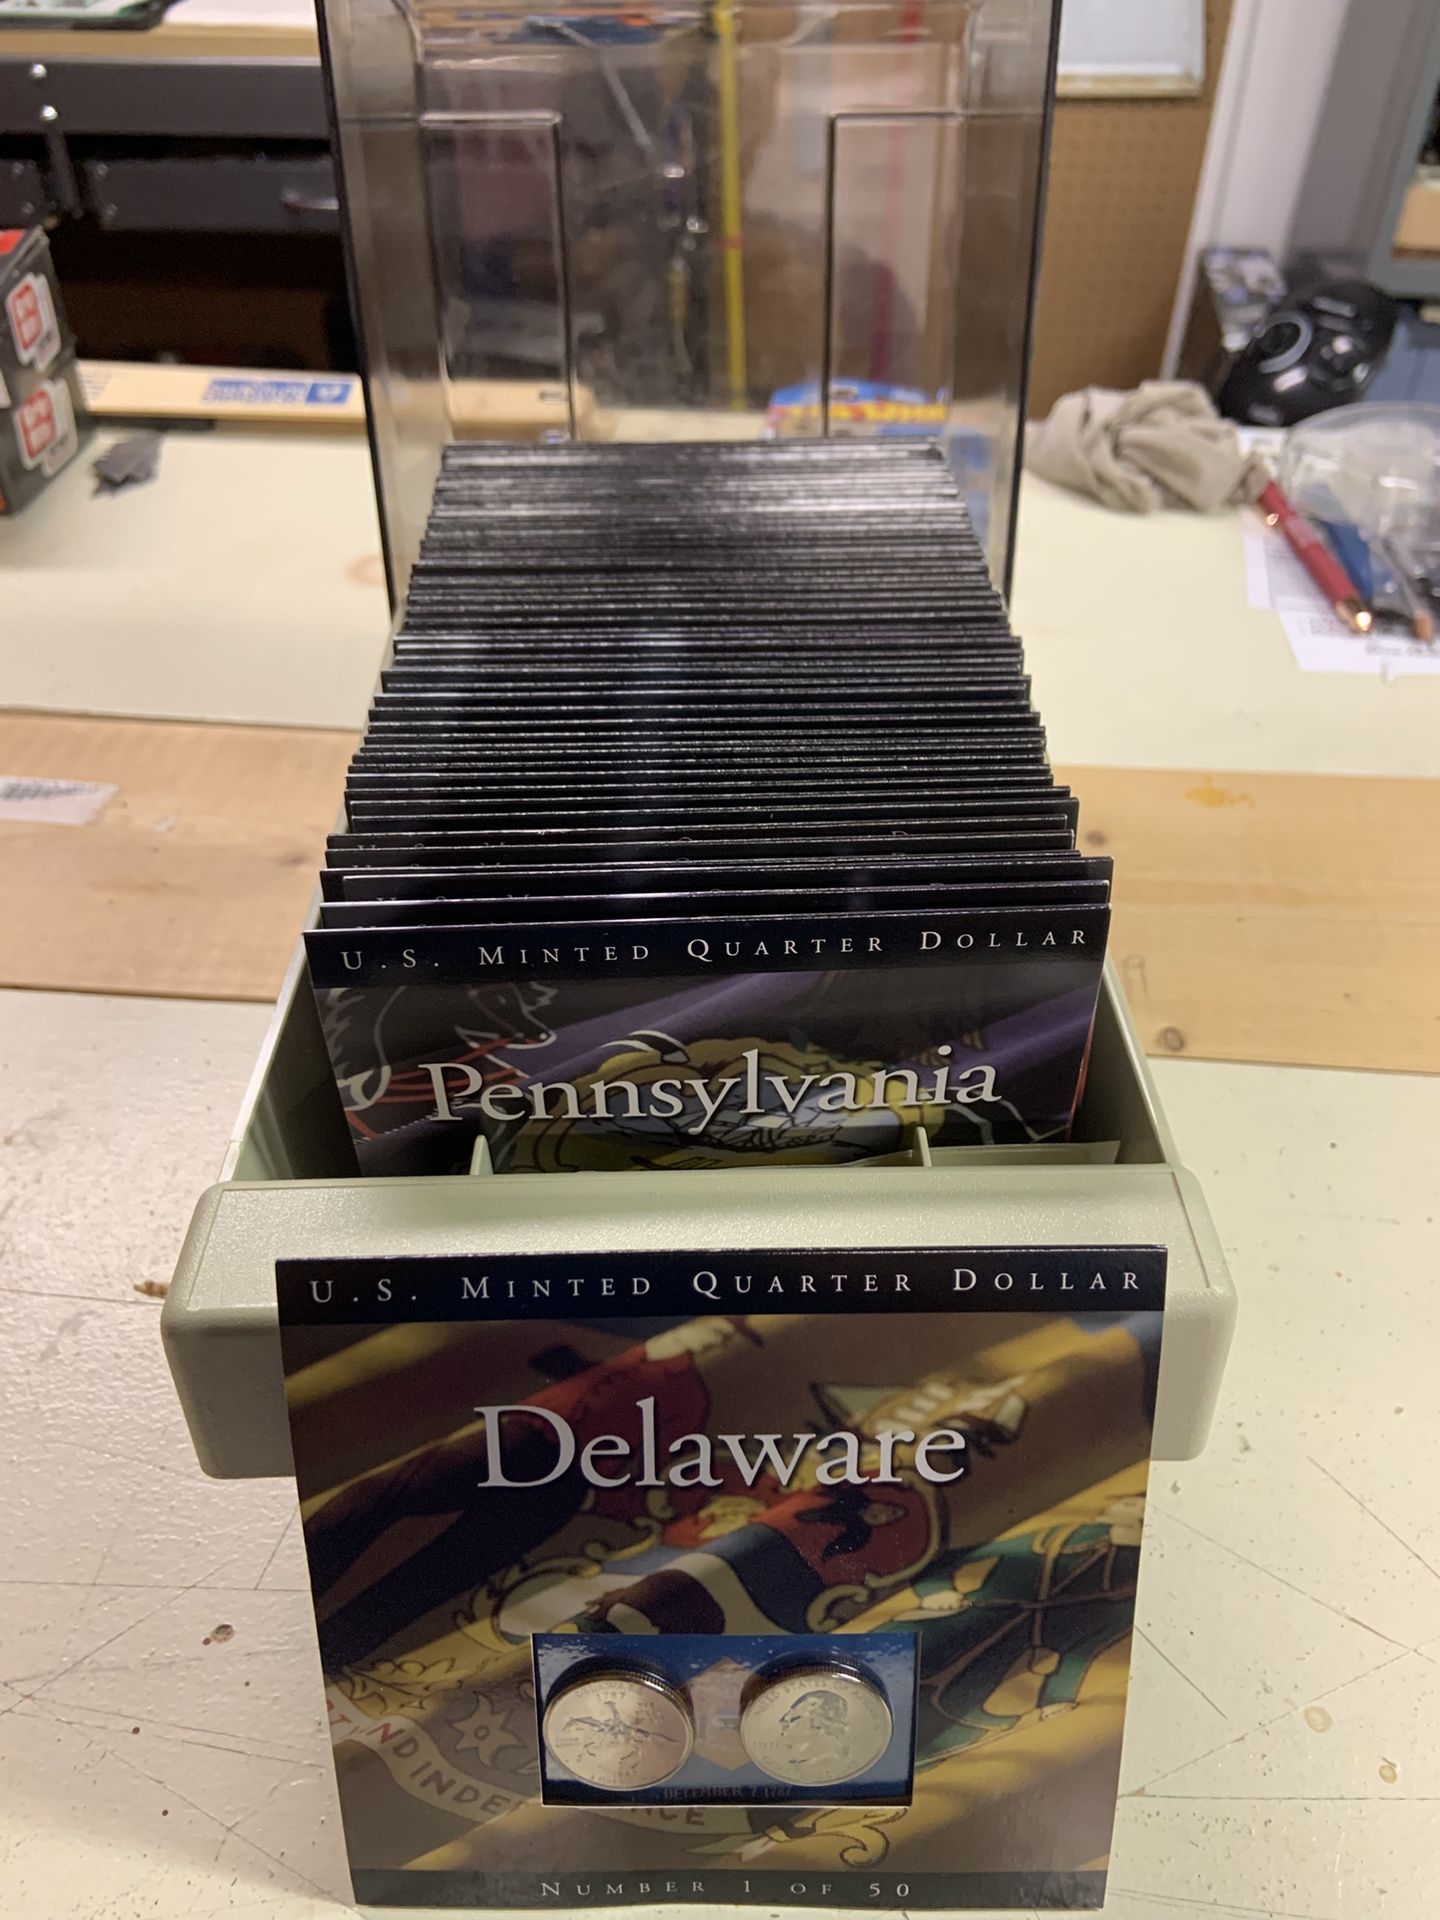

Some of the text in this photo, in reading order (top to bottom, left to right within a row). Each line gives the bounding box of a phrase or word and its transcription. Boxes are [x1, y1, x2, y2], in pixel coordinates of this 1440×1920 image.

[340, 929, 1088, 971] U.S. MINTED QUARTER DOLLAR
[417, 1044, 1003, 1136] Pennsylvania
[309, 1267, 1140, 1303] U.S. MINTED QUARTER DOLLAR
[473, 1395, 968, 1490] Delaware
[540, 1880, 911, 1898] NUMBER 1 OF 50
